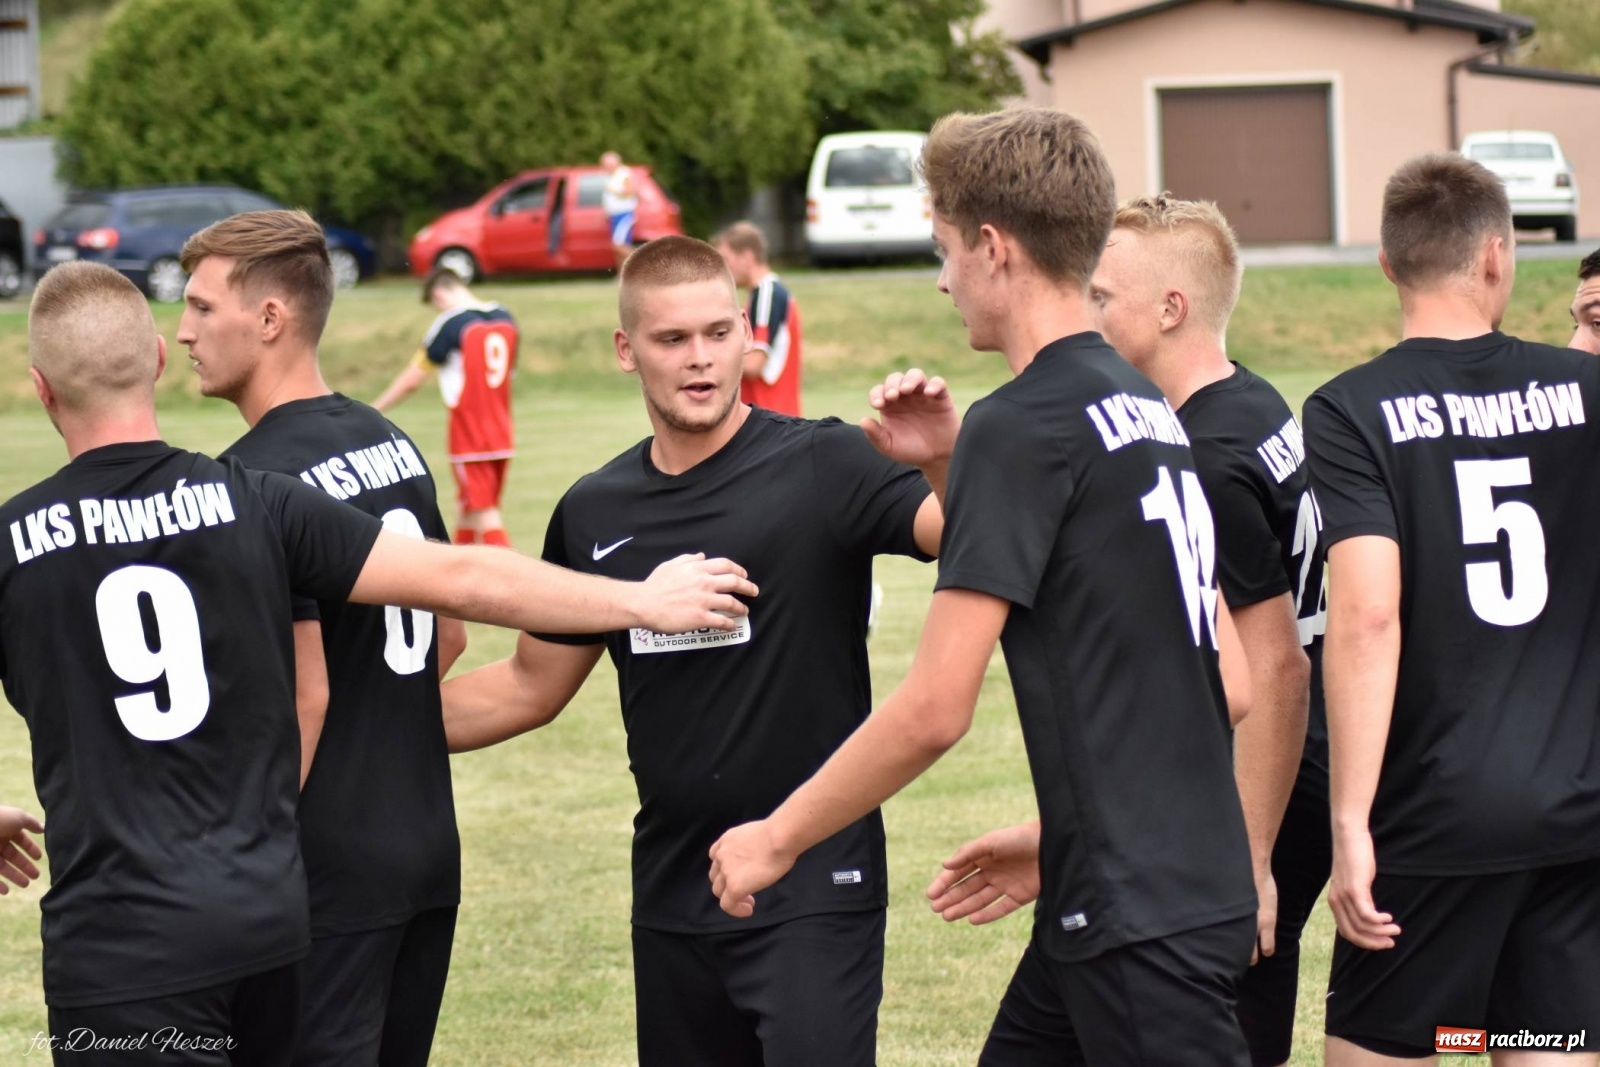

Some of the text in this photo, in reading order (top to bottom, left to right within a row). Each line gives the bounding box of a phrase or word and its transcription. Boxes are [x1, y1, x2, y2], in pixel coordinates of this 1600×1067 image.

[484, 331, 509, 389] 9
[1086, 392, 1150, 451] LKS
[1380, 381, 1586, 443] LKS PAWŁÓW
[1257, 435, 1296, 484] LKS
[10, 479, 235, 564] LKS PAWŁÓW
[1453, 457, 1548, 626] 5
[95, 565, 210, 741] 9
[654, 631, 745, 647] OUTDOOR SERVICE
